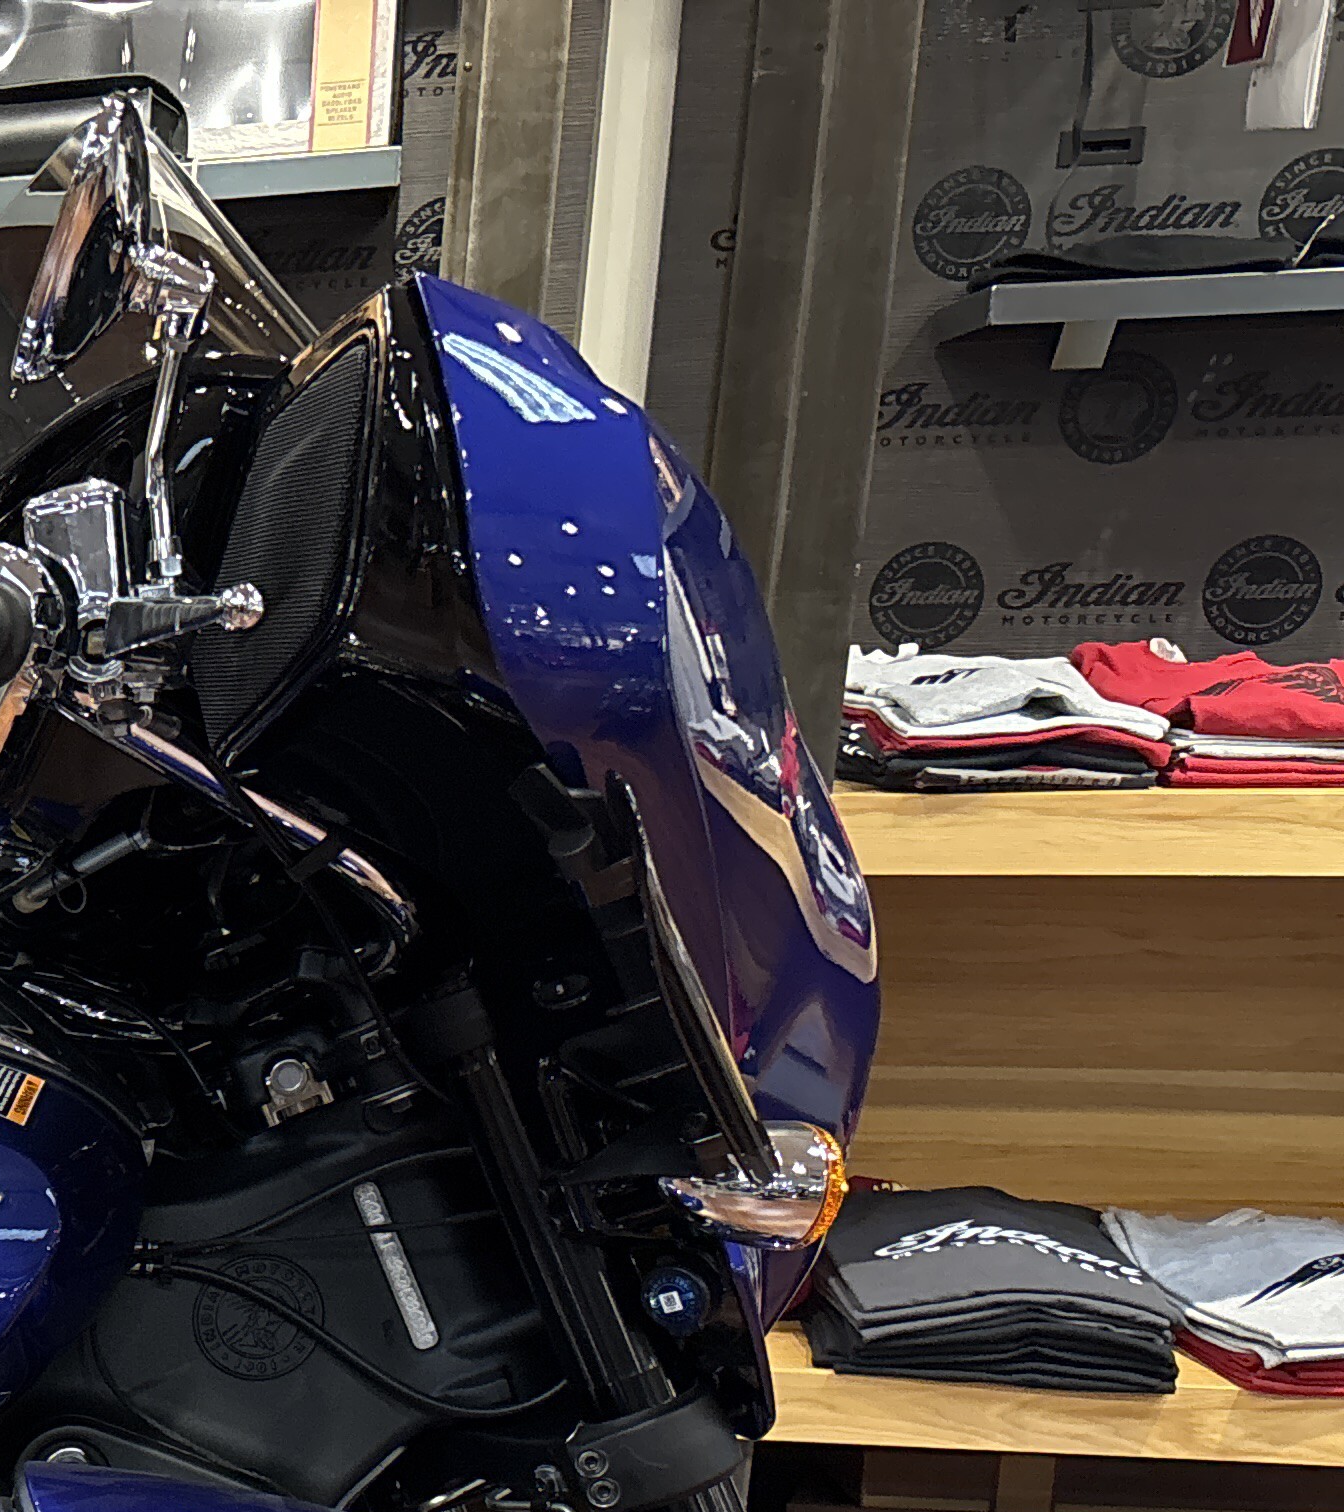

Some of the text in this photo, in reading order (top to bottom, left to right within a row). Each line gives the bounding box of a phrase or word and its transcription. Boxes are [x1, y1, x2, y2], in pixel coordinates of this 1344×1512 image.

[915, 205, 1027, 236] Indian
[1054, 184, 1242, 235] Indian
[872, 577, 980, 605] Indian
[997, 562, 1186, 610] Indian
[1205, 573, 1318, 601] Indian
[1002, 613, 1174, 625] MOTORCYCLE
